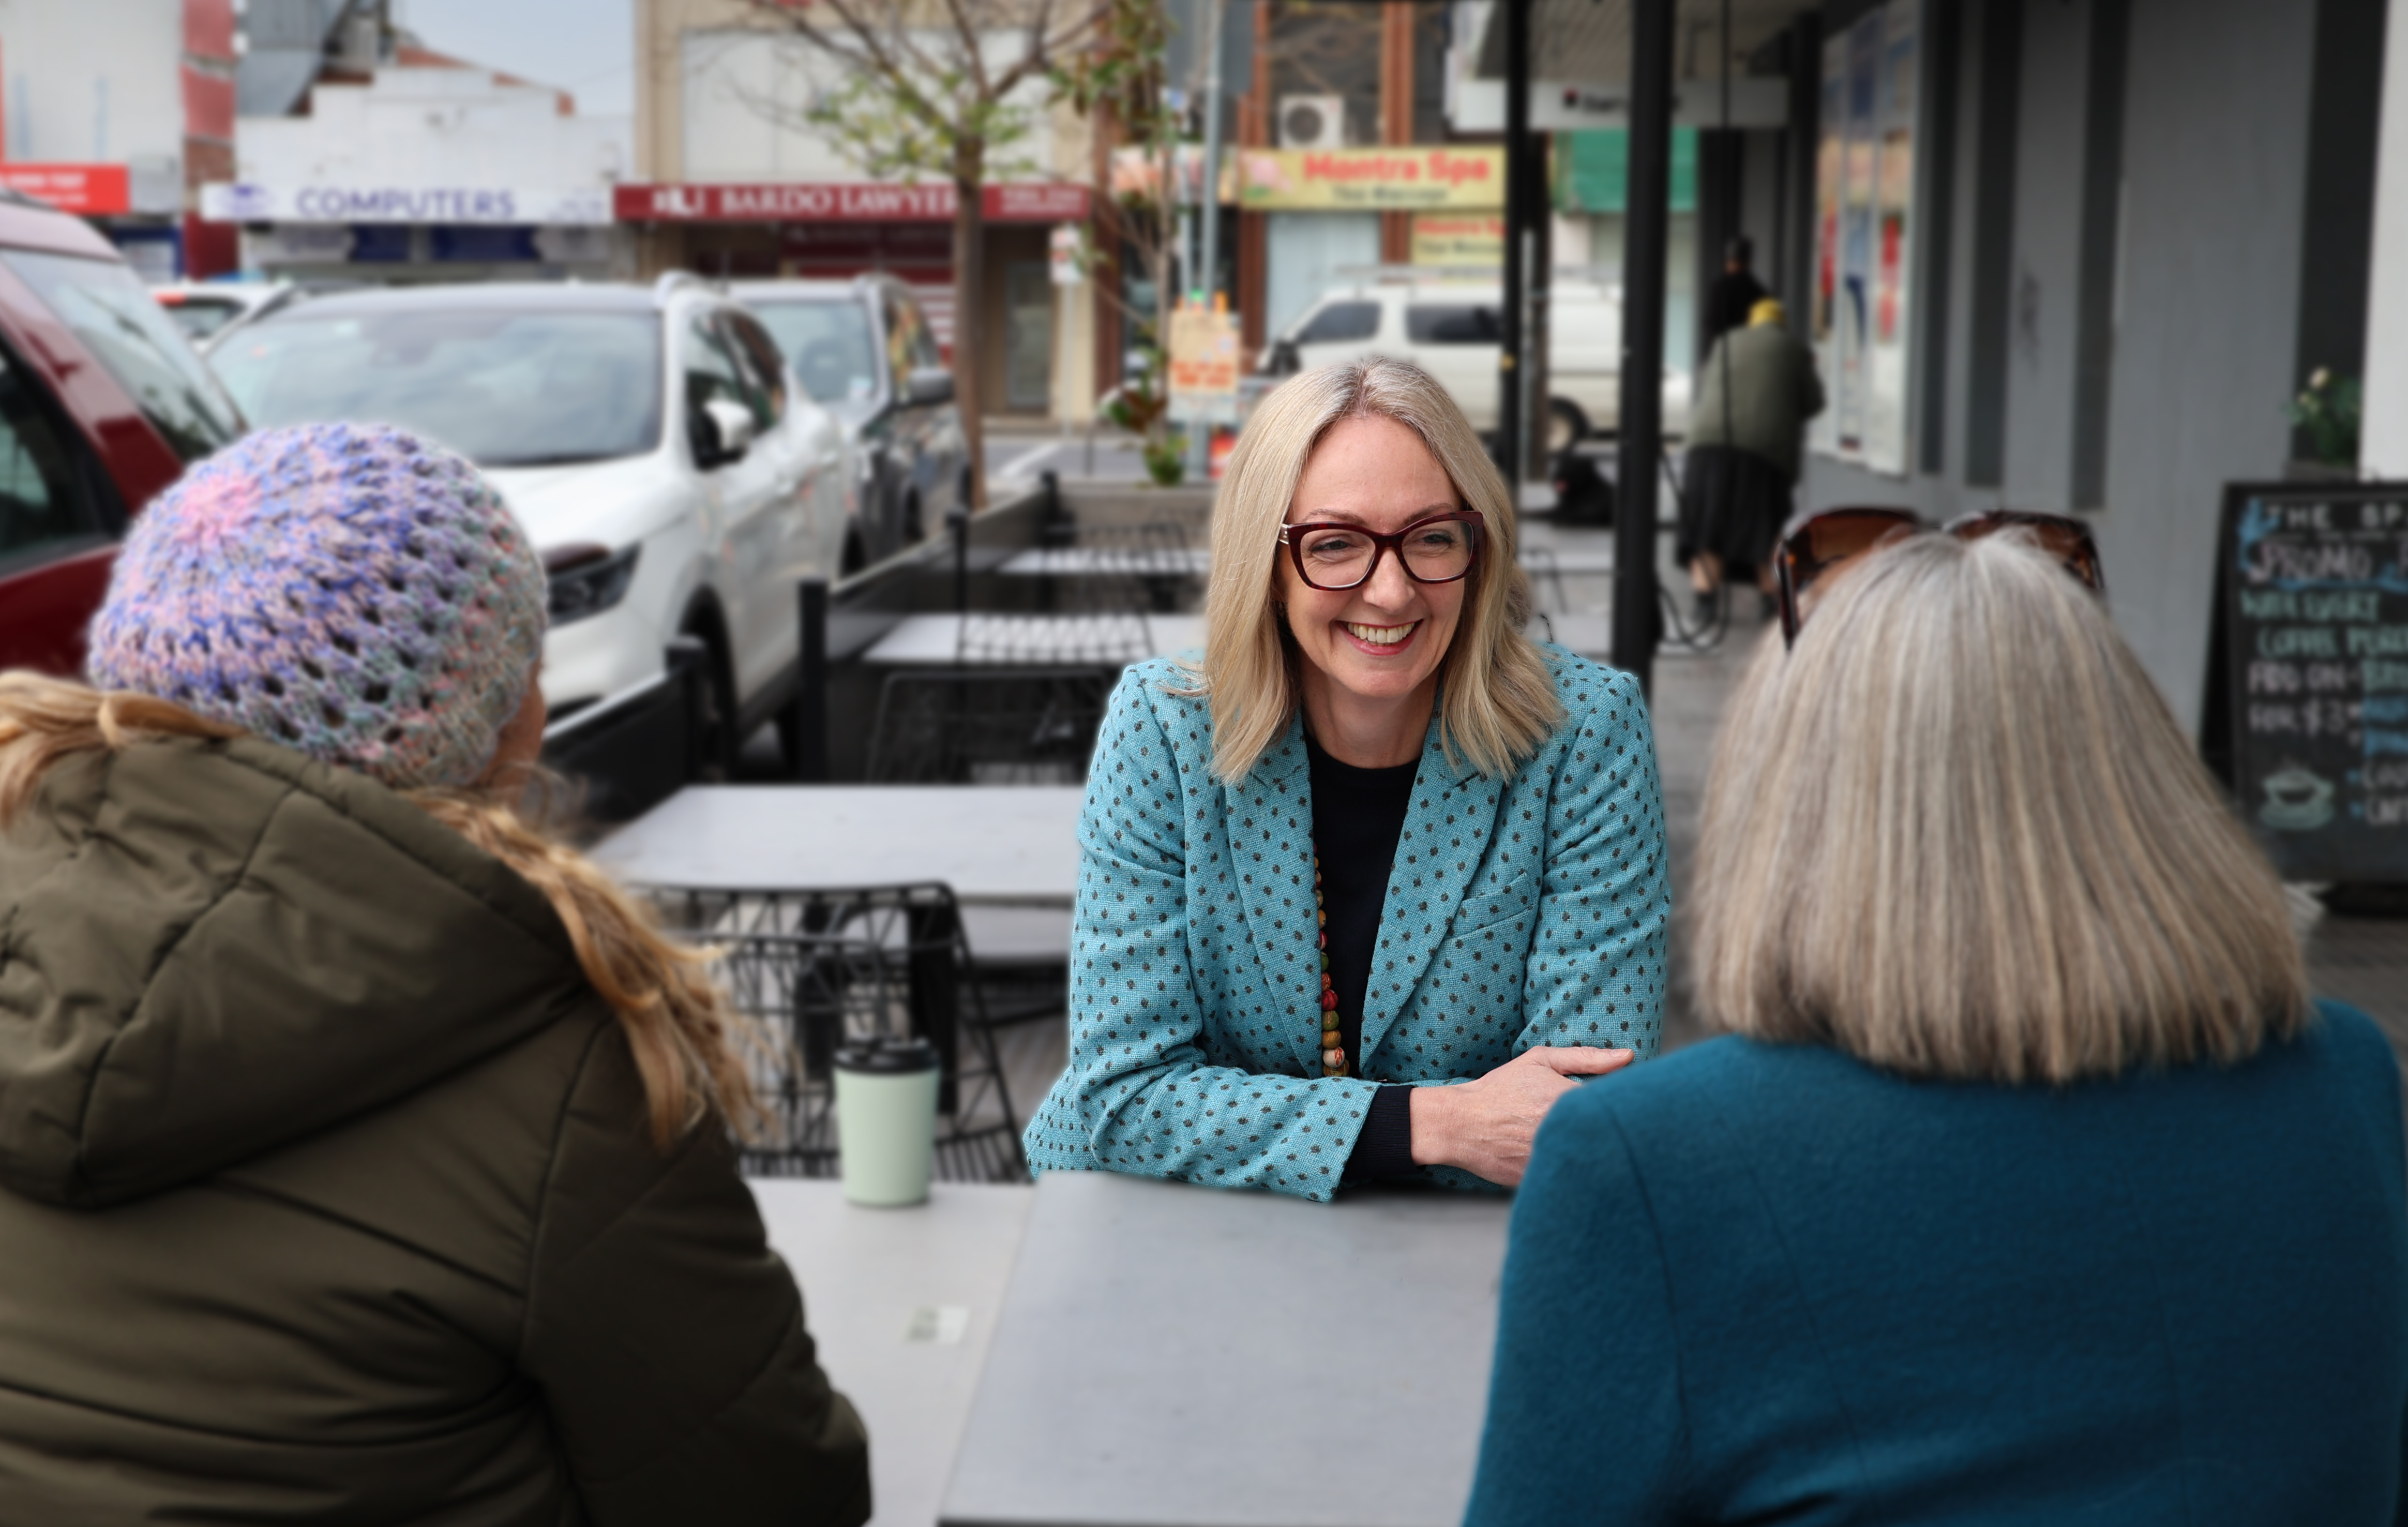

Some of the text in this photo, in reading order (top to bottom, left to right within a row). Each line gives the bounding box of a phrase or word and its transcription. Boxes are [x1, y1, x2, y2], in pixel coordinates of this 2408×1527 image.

[1303, 152, 1489, 187] Mantra Spa
[296, 188, 516, 217] COMPUTERS
[721, 187, 832, 214] BARDO
[839, 187, 958, 214] LAWYER
[2266, 503, 2330, 529] THE
[2248, 542, 2372, 582] PROMO
